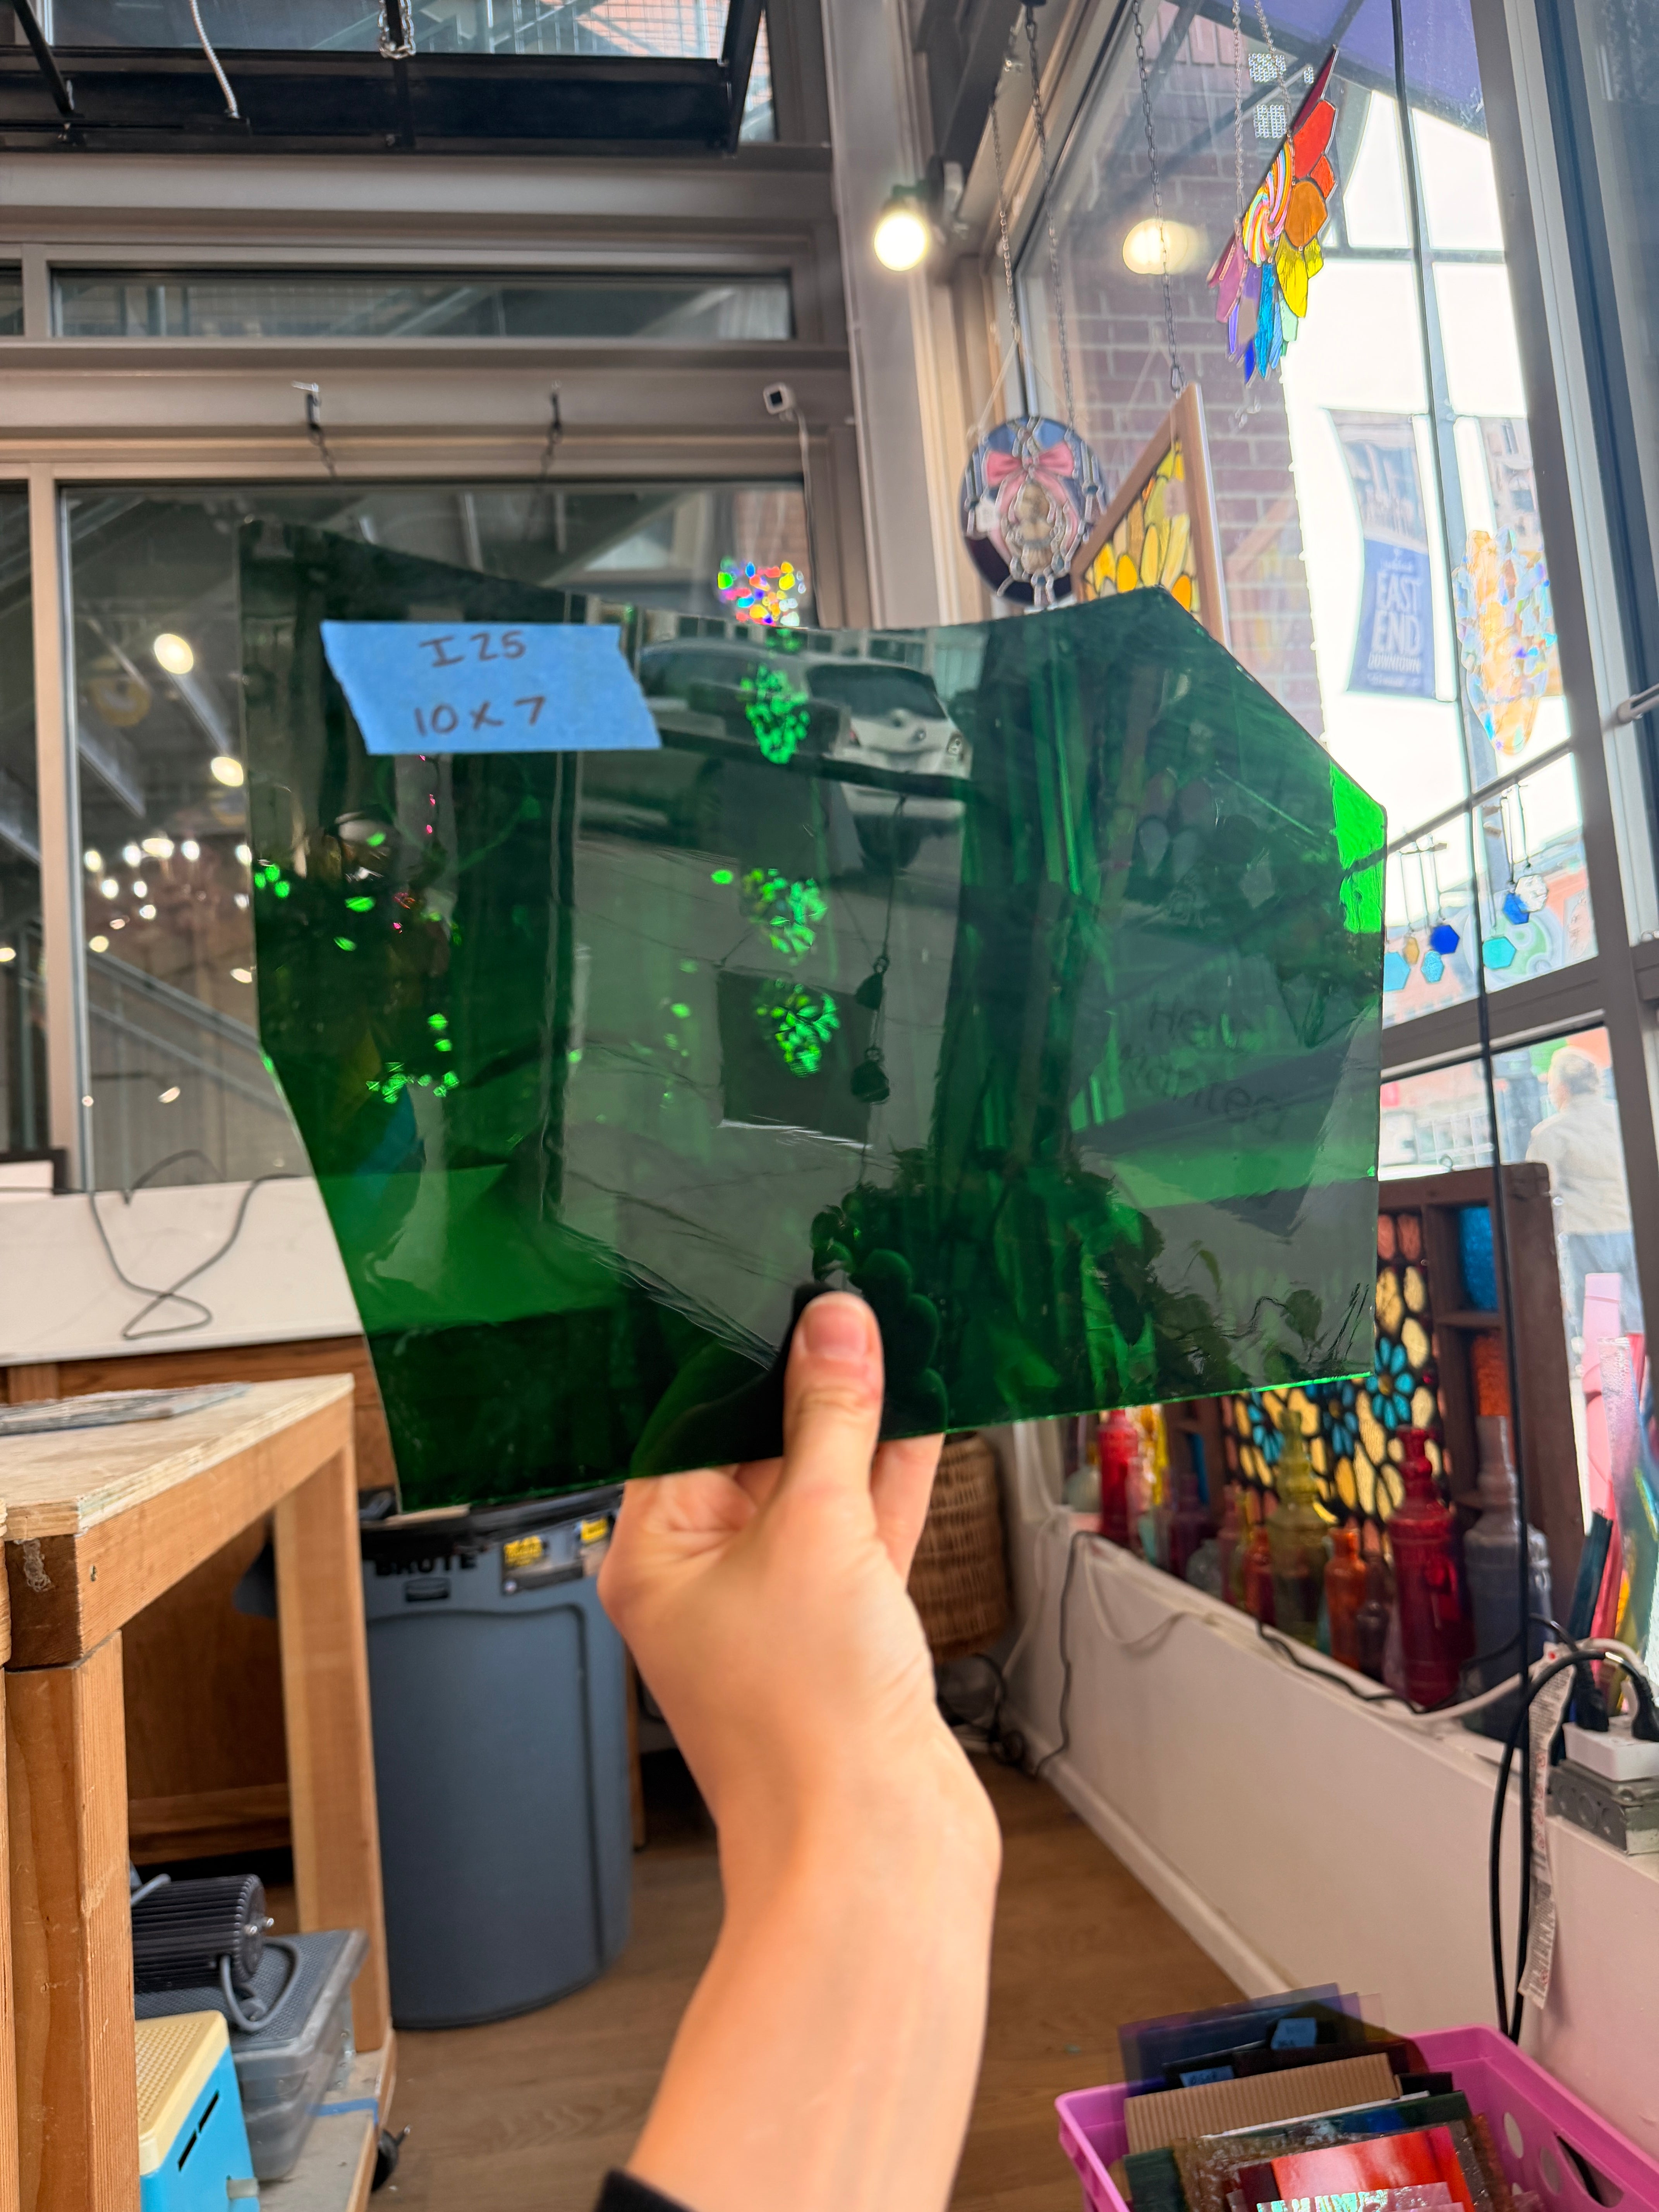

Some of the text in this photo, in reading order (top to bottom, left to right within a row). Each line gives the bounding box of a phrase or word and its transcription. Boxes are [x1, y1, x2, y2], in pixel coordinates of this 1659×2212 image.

[1376, 569, 1422, 615] EAST
[1371, 609, 1422, 656] END
[1368, 650, 1421, 674] DOWNTOWN
